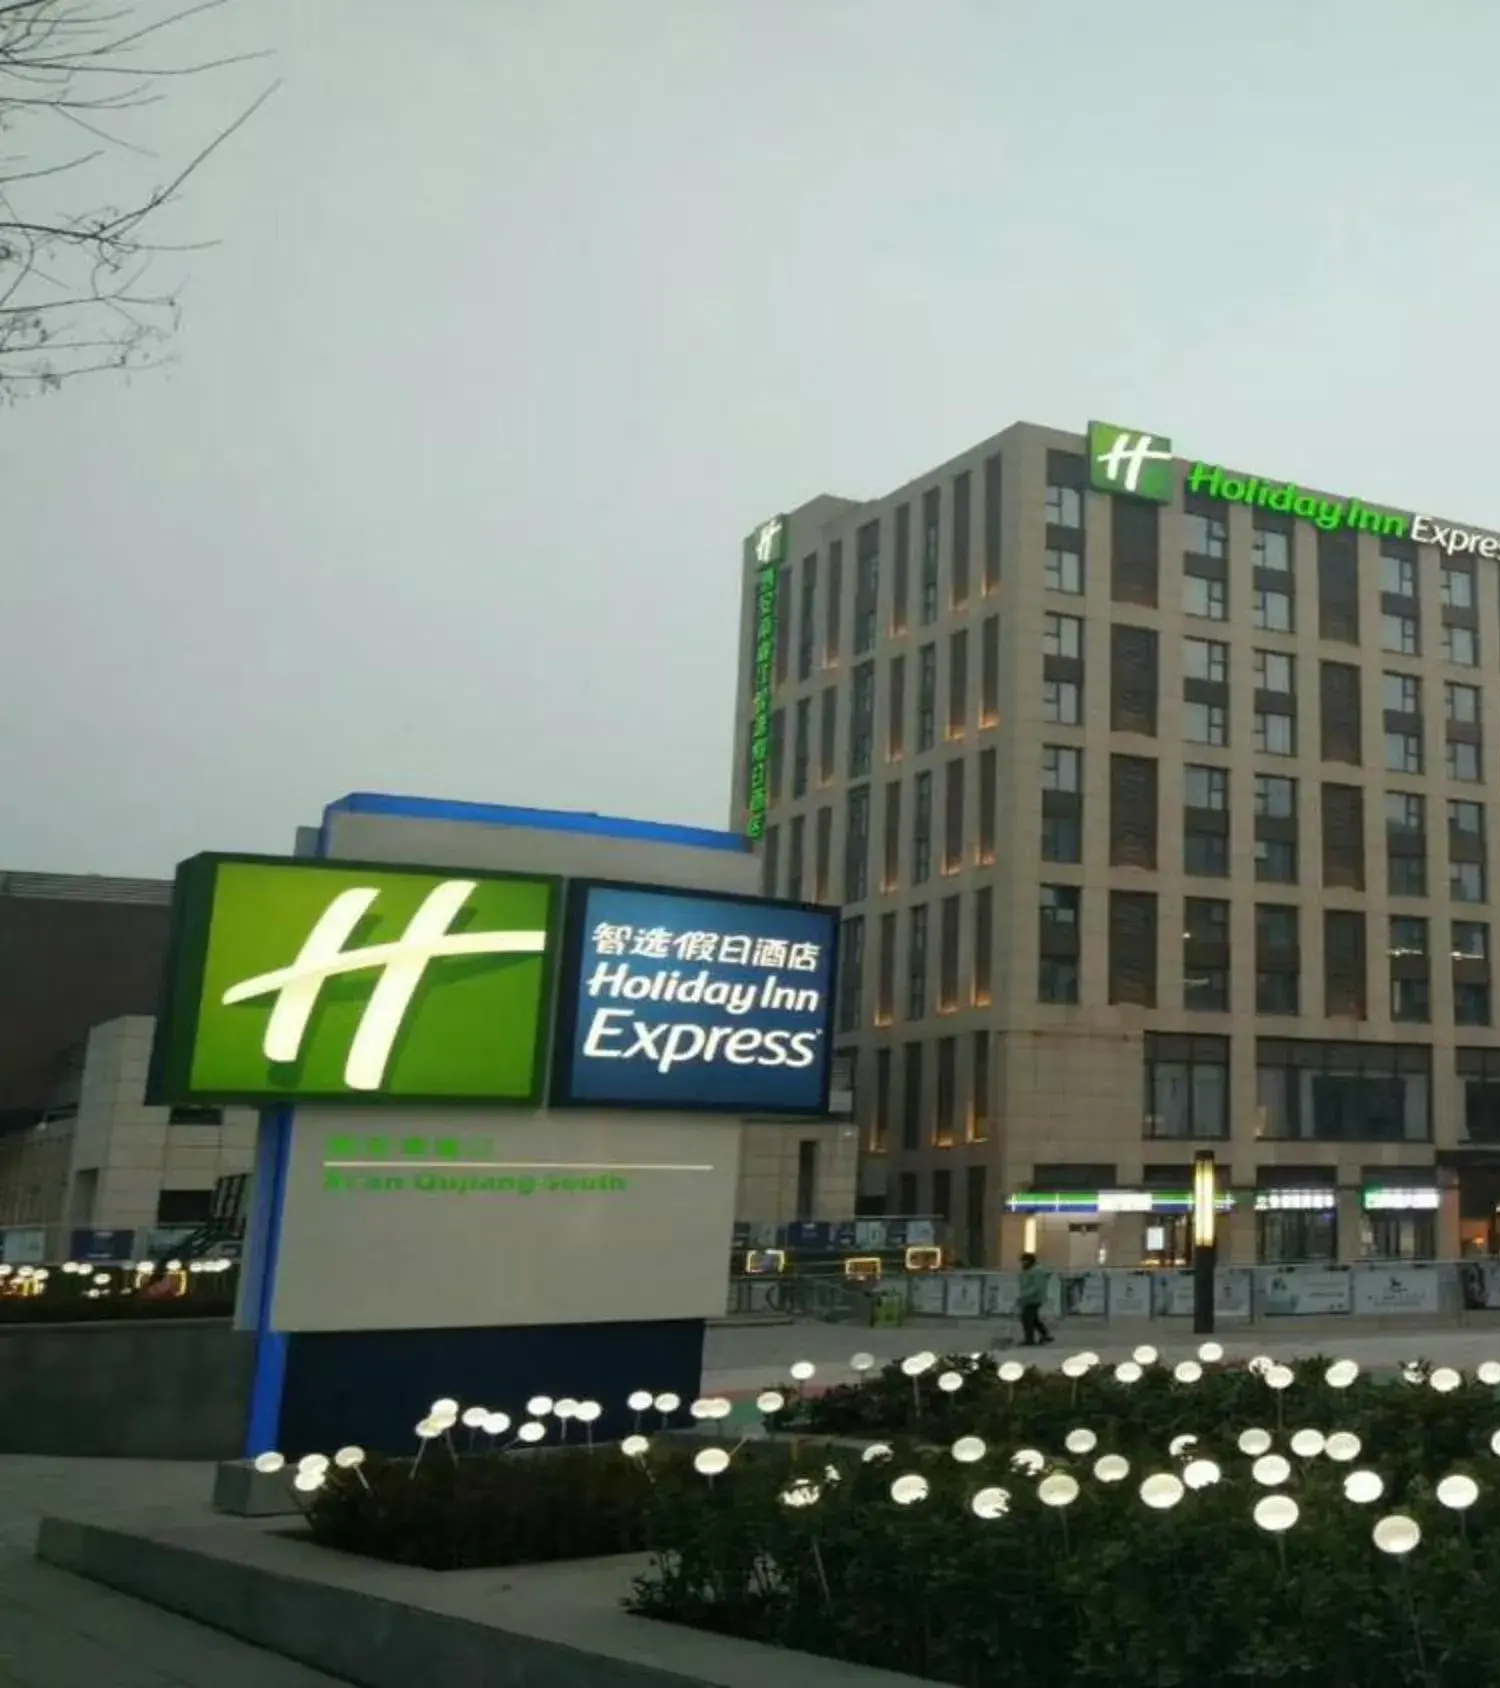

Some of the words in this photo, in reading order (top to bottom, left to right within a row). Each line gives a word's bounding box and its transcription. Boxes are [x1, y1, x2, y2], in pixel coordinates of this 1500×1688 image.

[1187, 460, 1342, 529] Holiday
[1346, 497, 1408, 538] Inn
[591, 921, 820, 972] 智选假日酒店
[586, 961, 757, 1016] Holiday
[760, 975, 819, 1013] Inn
[583, 1007, 818, 1074] Express
